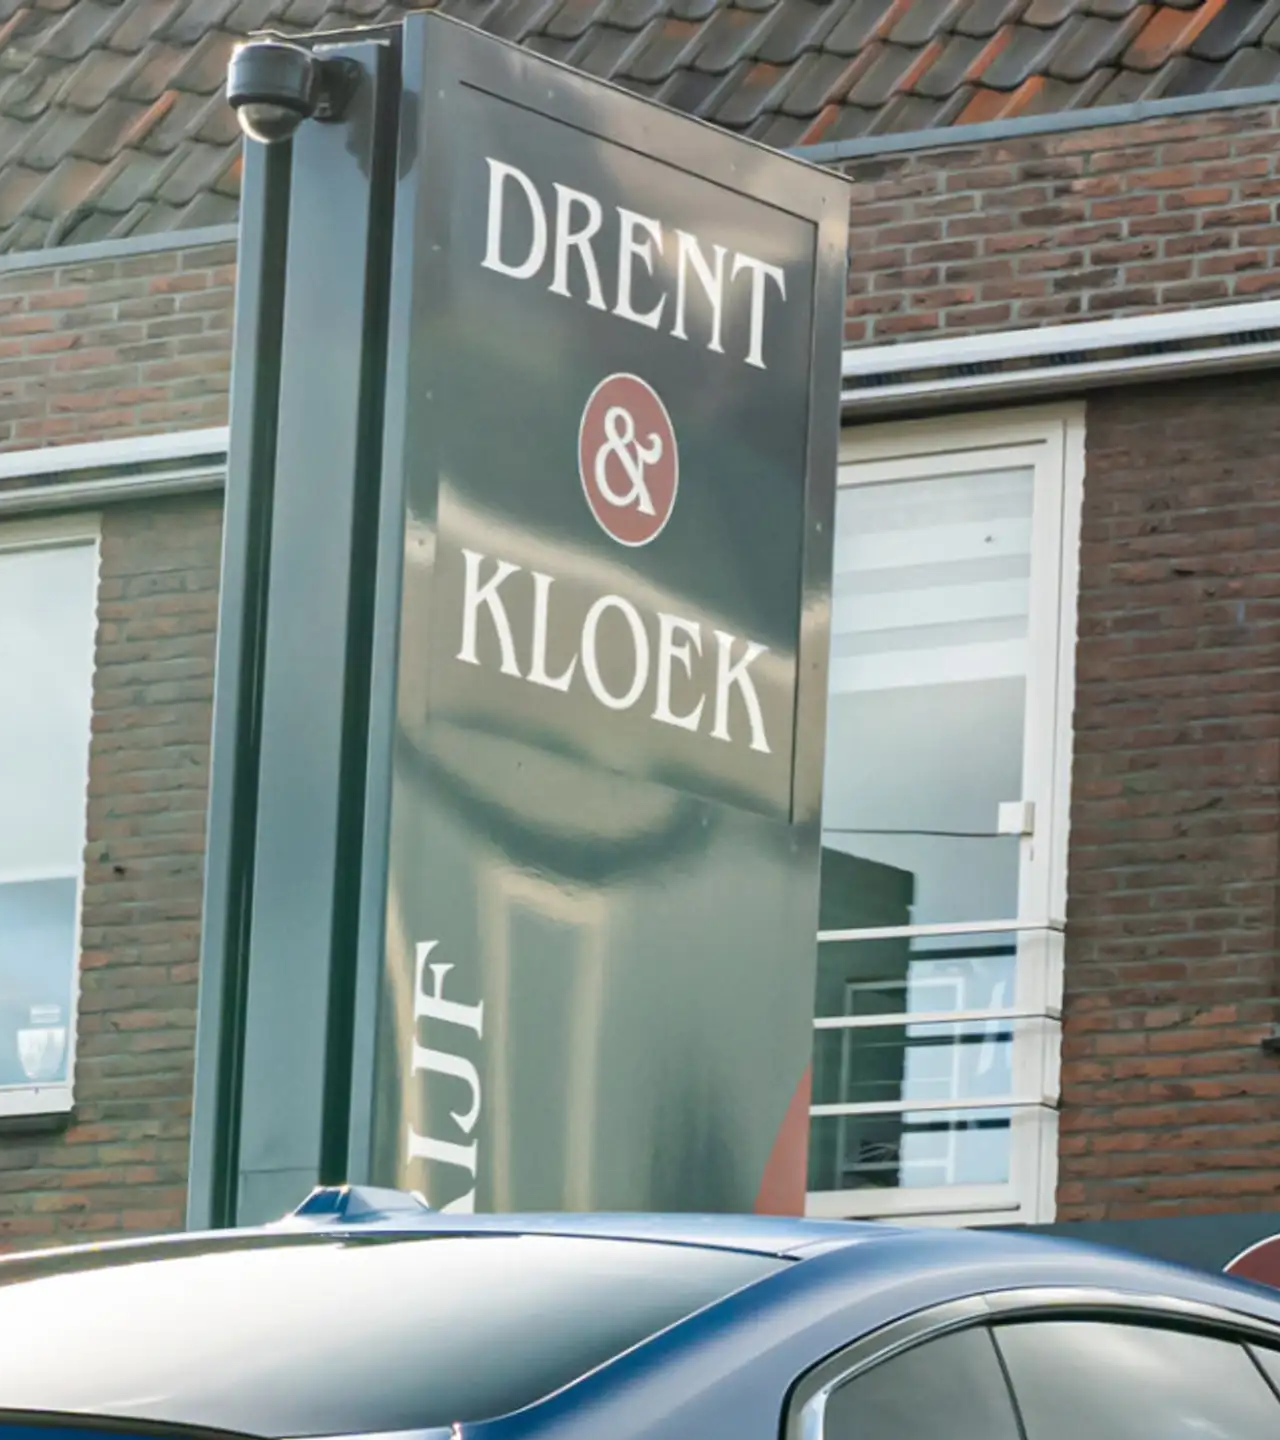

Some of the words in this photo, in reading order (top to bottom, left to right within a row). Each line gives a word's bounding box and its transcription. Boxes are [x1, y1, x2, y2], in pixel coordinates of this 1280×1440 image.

[480, 157, 787, 369] DRENT
[594, 405, 663, 517] &
[455, 547, 772, 755] KLOEK
[407, 940, 484, 1214] IJF
